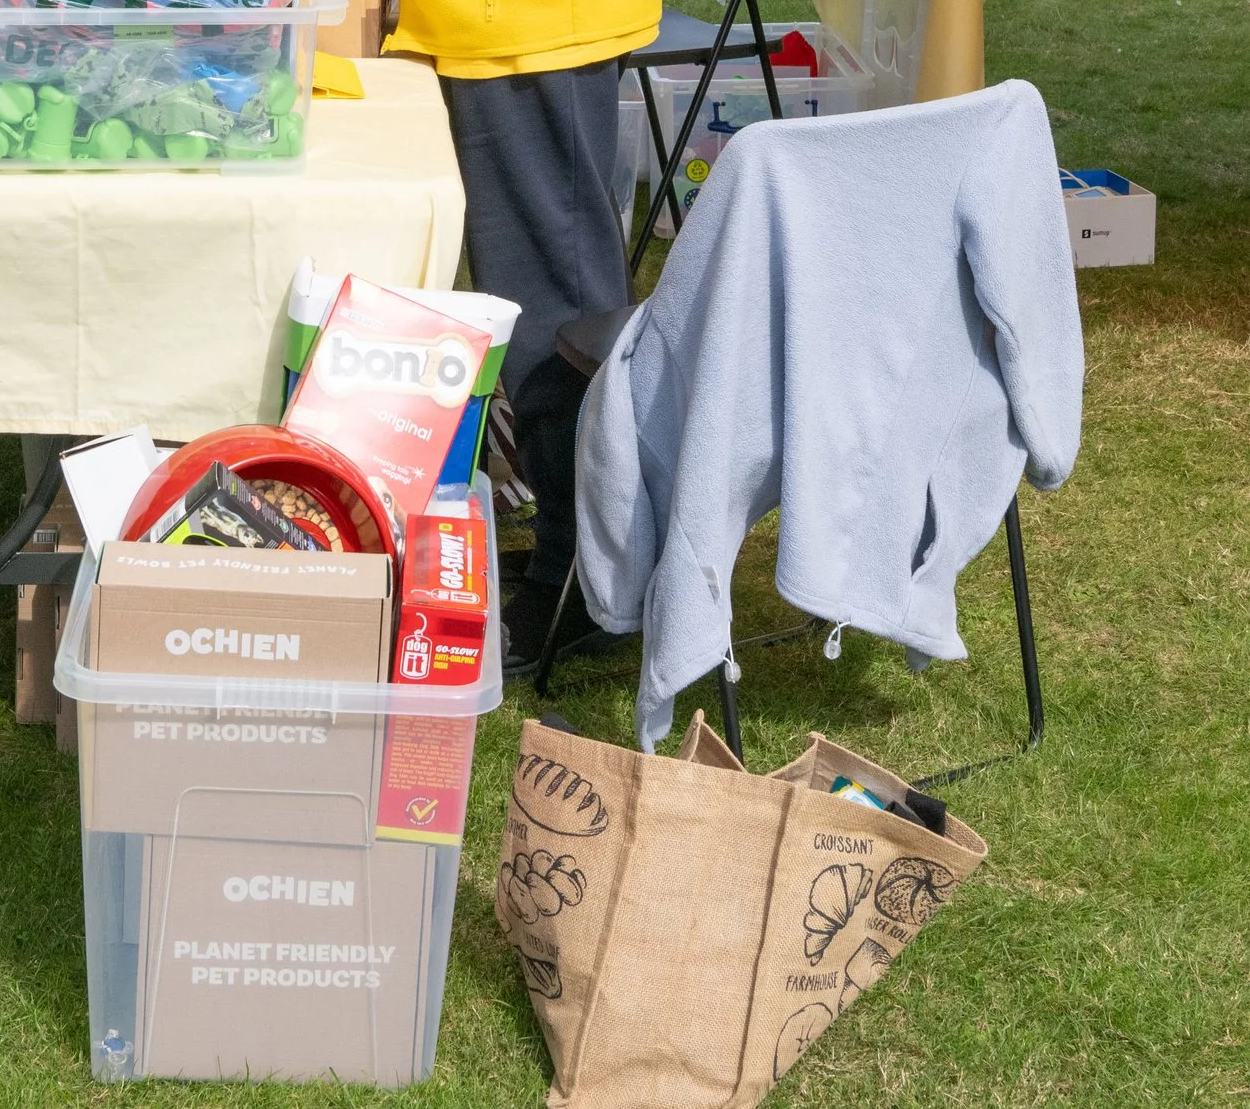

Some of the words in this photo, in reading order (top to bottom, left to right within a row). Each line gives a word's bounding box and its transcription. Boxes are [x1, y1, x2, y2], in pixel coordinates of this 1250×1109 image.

[377, 409, 434, 442] original
[117, 556, 171, 569] BOWLS
[179, 558, 205, 568] PET
[212, 560, 290, 575] FRIENDLY
[297, 564, 358, 576] PLANET
[438, 533, 466, 589] GO-SLOW!
[165, 628, 300, 661] OCHIEN
[406, 640, 428, 653] dog
[435, 644, 480, 657] GO-SLOW!
[406, 653, 425, 674] it
[134, 721, 182, 740] PET
[187, 722, 327, 744] PRODUCTS
[813, 833, 874, 856] CROISSANT
[223, 875, 355, 906] OCHIEN
[174, 940, 272, 961] PLANET
[277, 943, 396, 964] FRIENDLY
[191, 966, 239, 985] PET
[243, 968, 380, 988] PRODUCTS
[786, 971, 839, 991] FARMHOUSE
